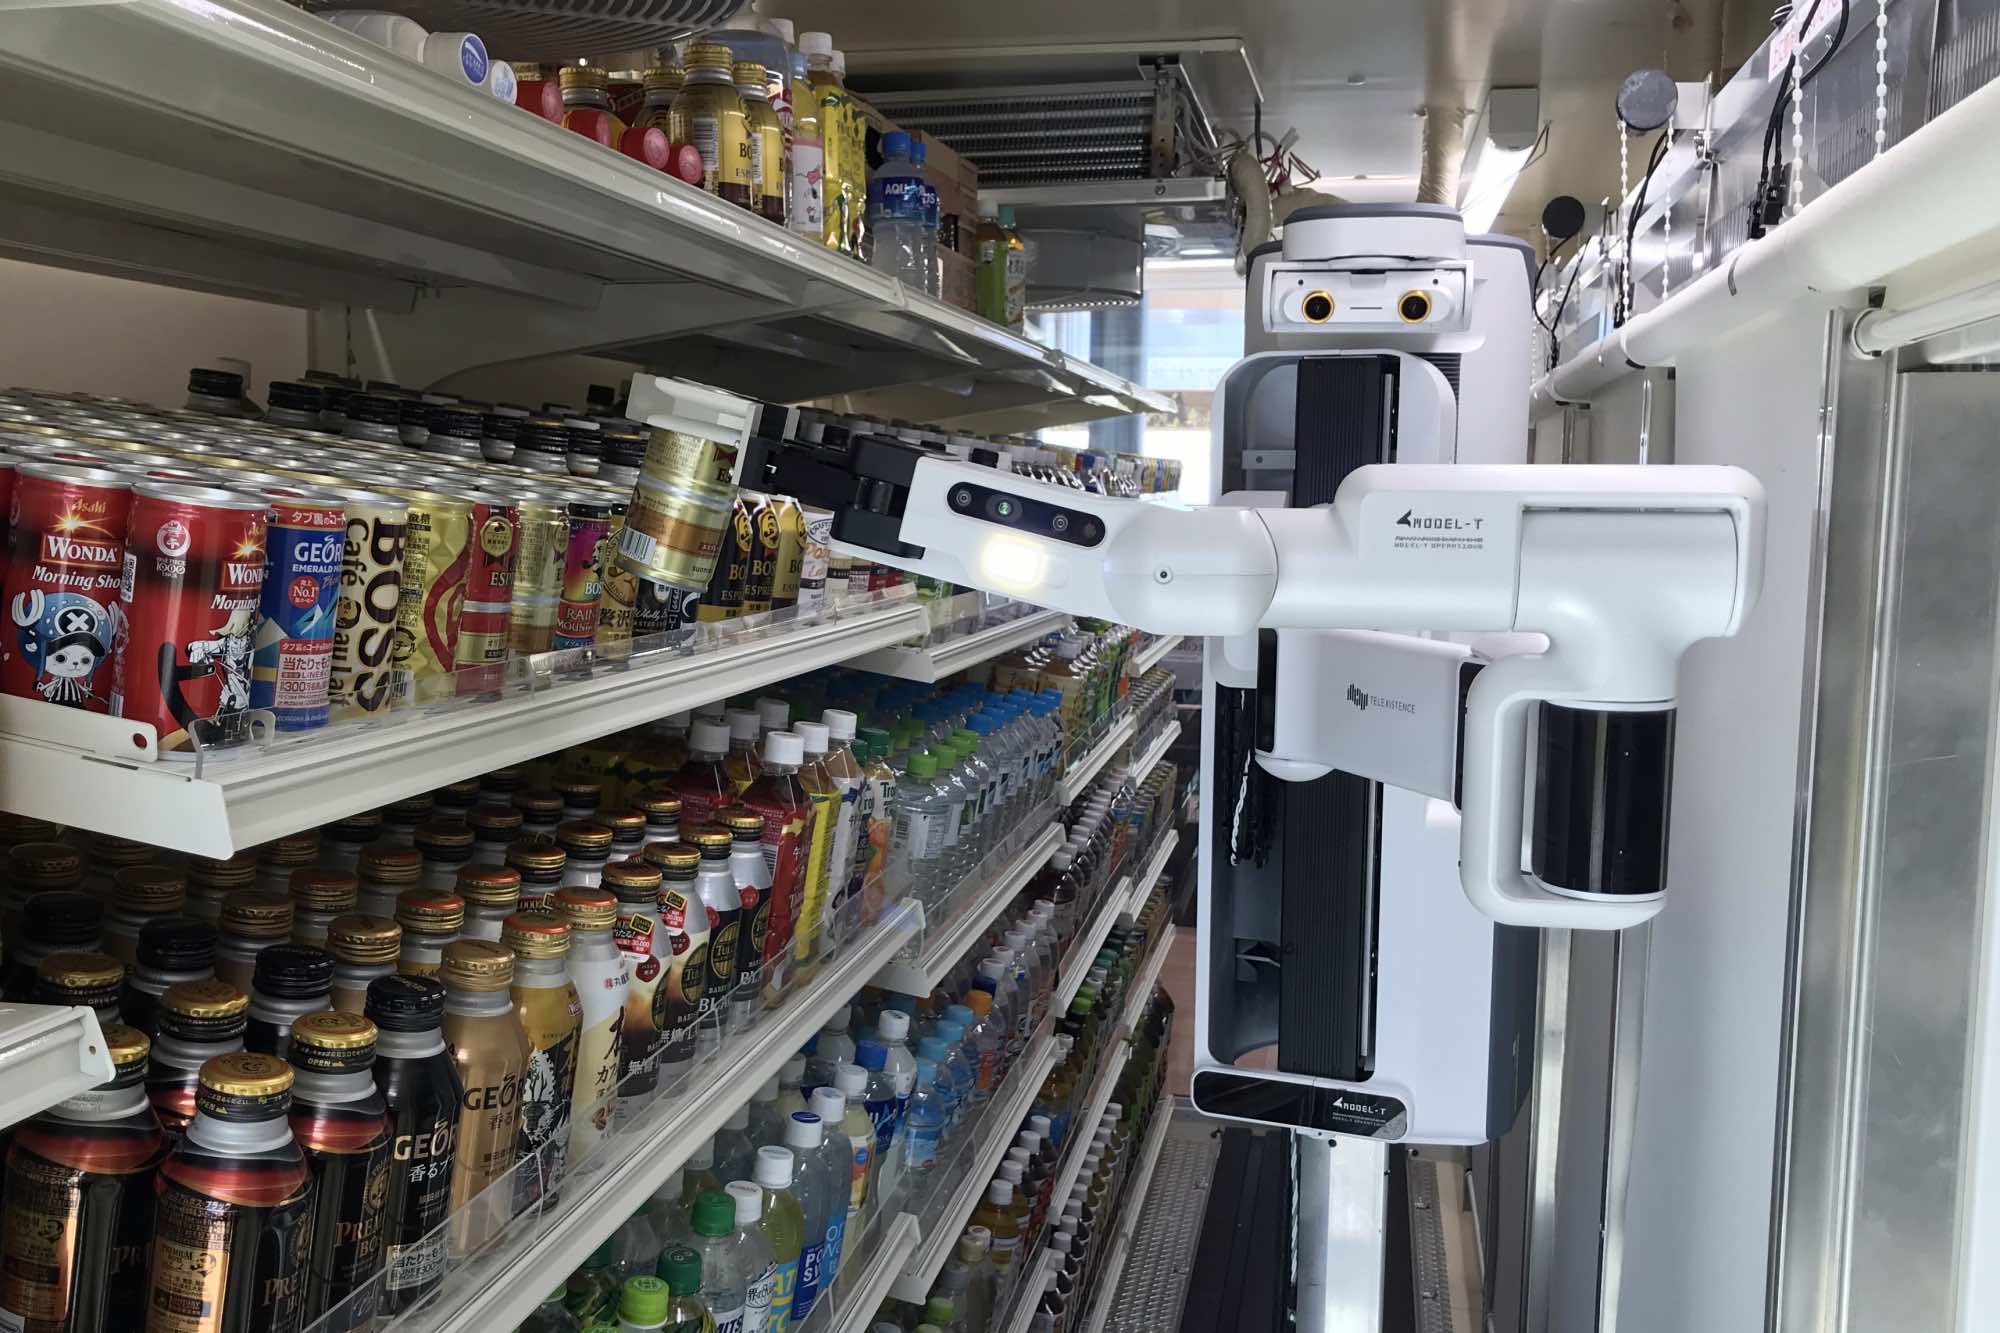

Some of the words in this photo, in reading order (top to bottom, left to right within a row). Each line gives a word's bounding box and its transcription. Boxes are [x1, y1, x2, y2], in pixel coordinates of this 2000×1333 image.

[71, 498, 107, 513] Asahi
[1413, 517, 1484, 530] MODEL-T
[47, 535, 117, 563] WONDA
[292, 563, 333, 574] EMERALD
[31, 565, 94, 591] Morning
[210, 593, 257, 613] Morning
[354, 517, 407, 712] BOSS
[307, 1057, 332, 1067] OPEN
[1343, 1102, 1387, 1116] MODEL-T
